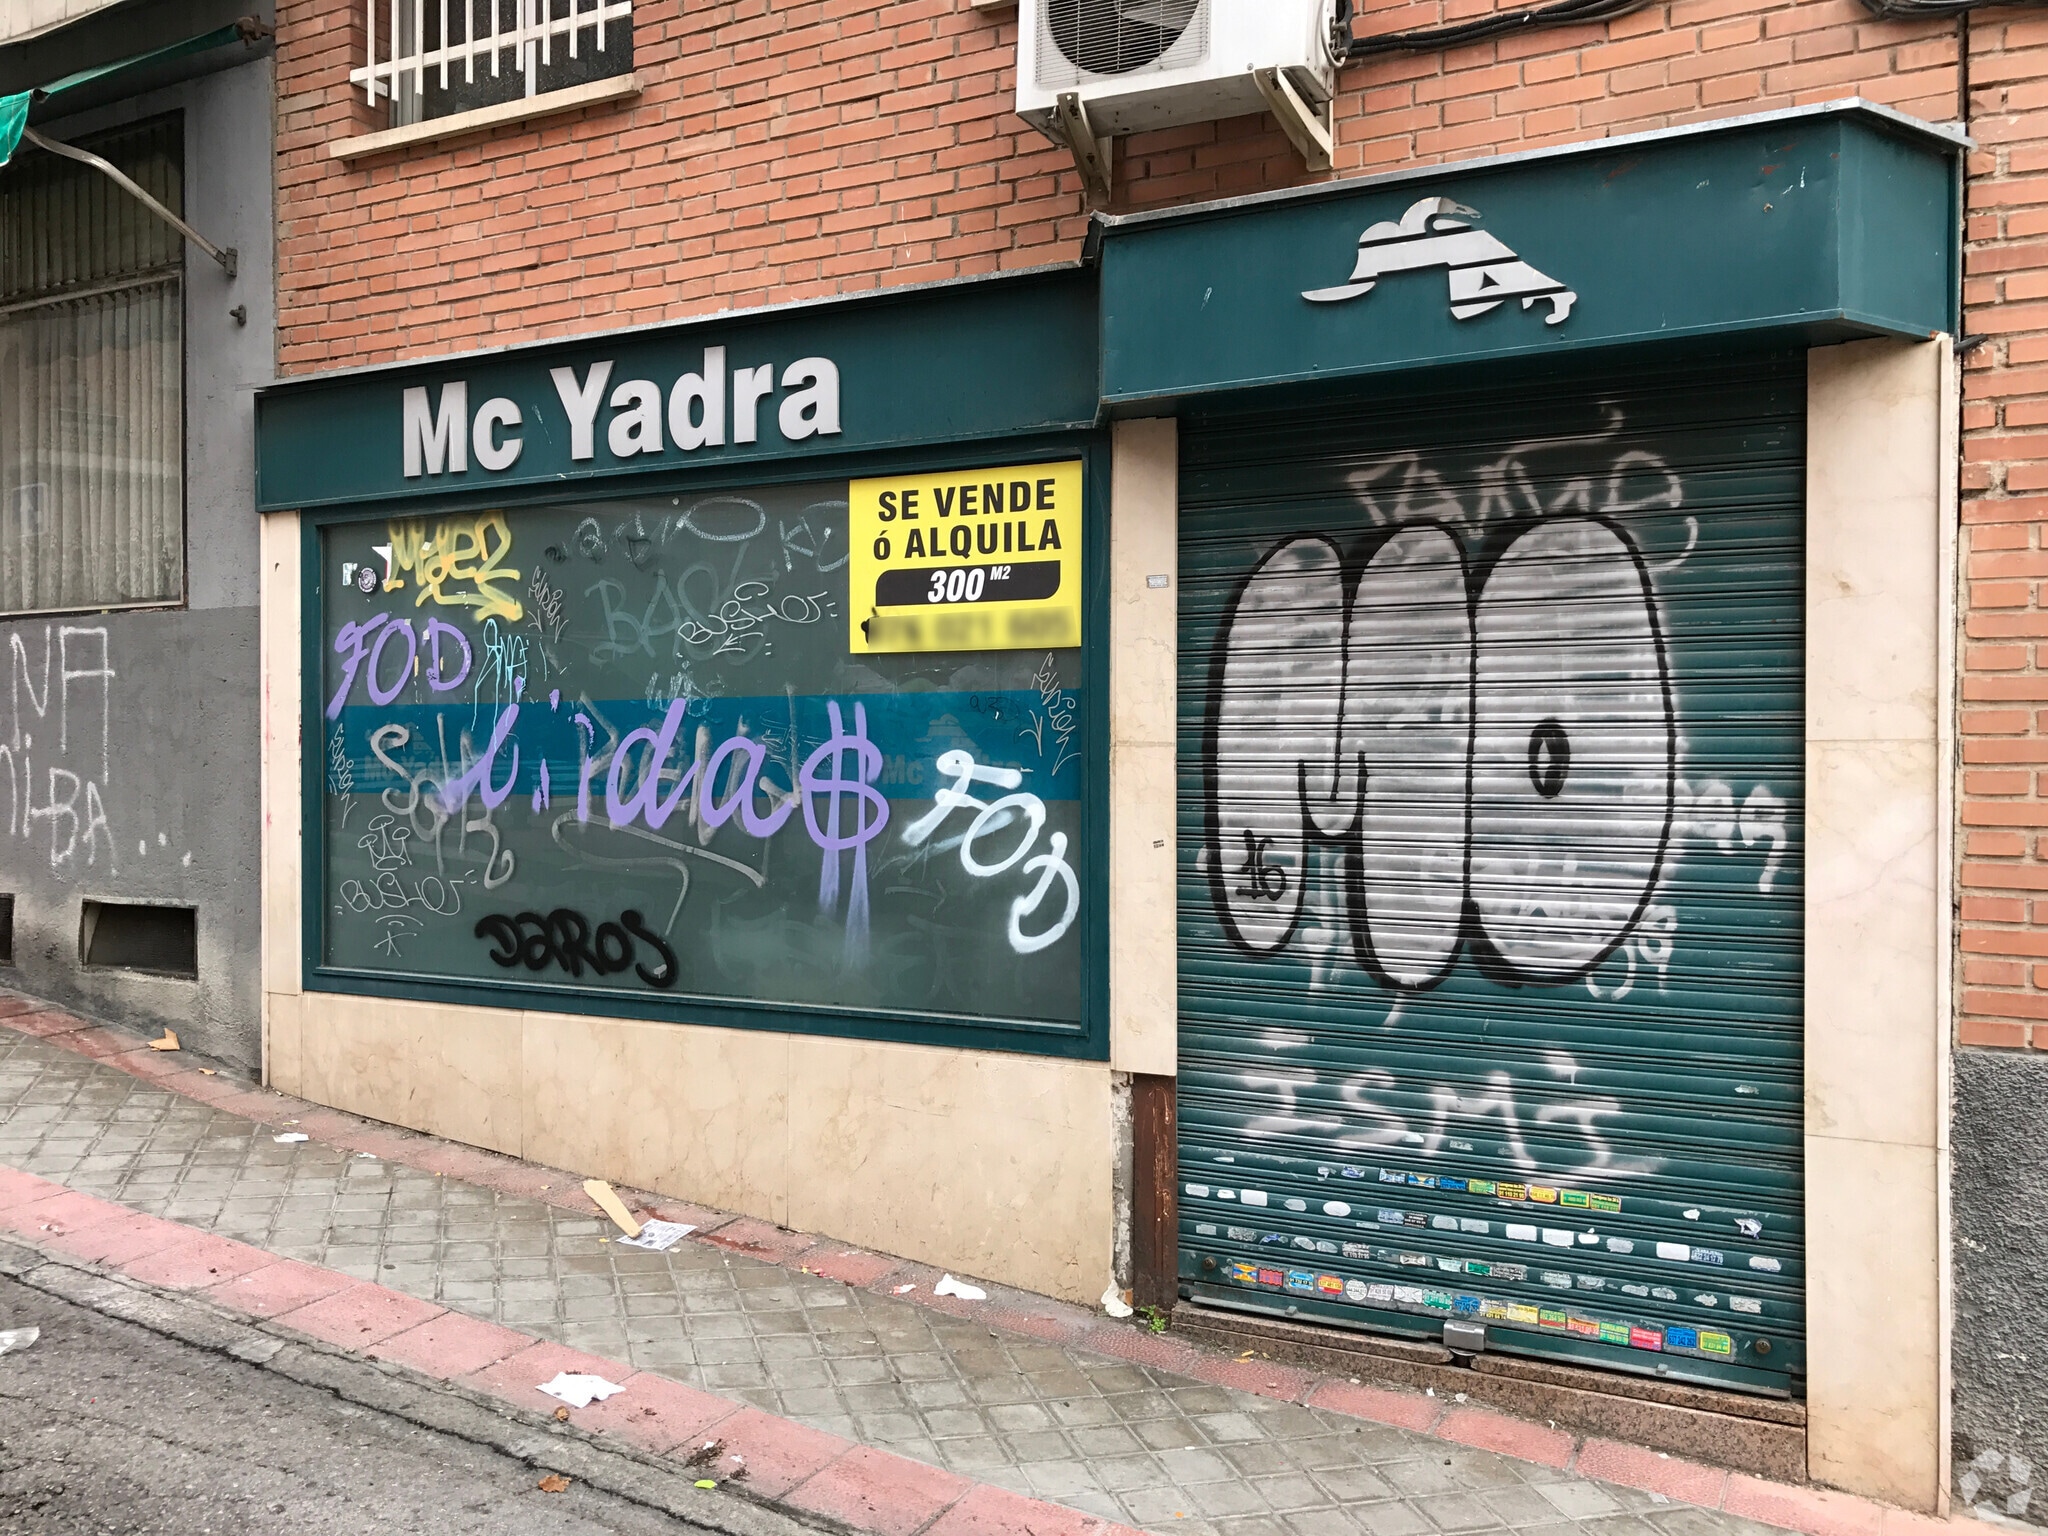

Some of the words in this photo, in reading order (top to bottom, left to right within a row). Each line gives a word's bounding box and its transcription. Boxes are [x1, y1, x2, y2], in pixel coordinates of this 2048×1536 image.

[403, 380, 523, 478] Mc
[549, 345, 844, 461] Yadra
[878, 490, 919, 522] SE
[933, 478, 1056, 518] VENDE
[904, 519, 1062, 559] ALQUILA
[927, 568, 986, 603] 300
